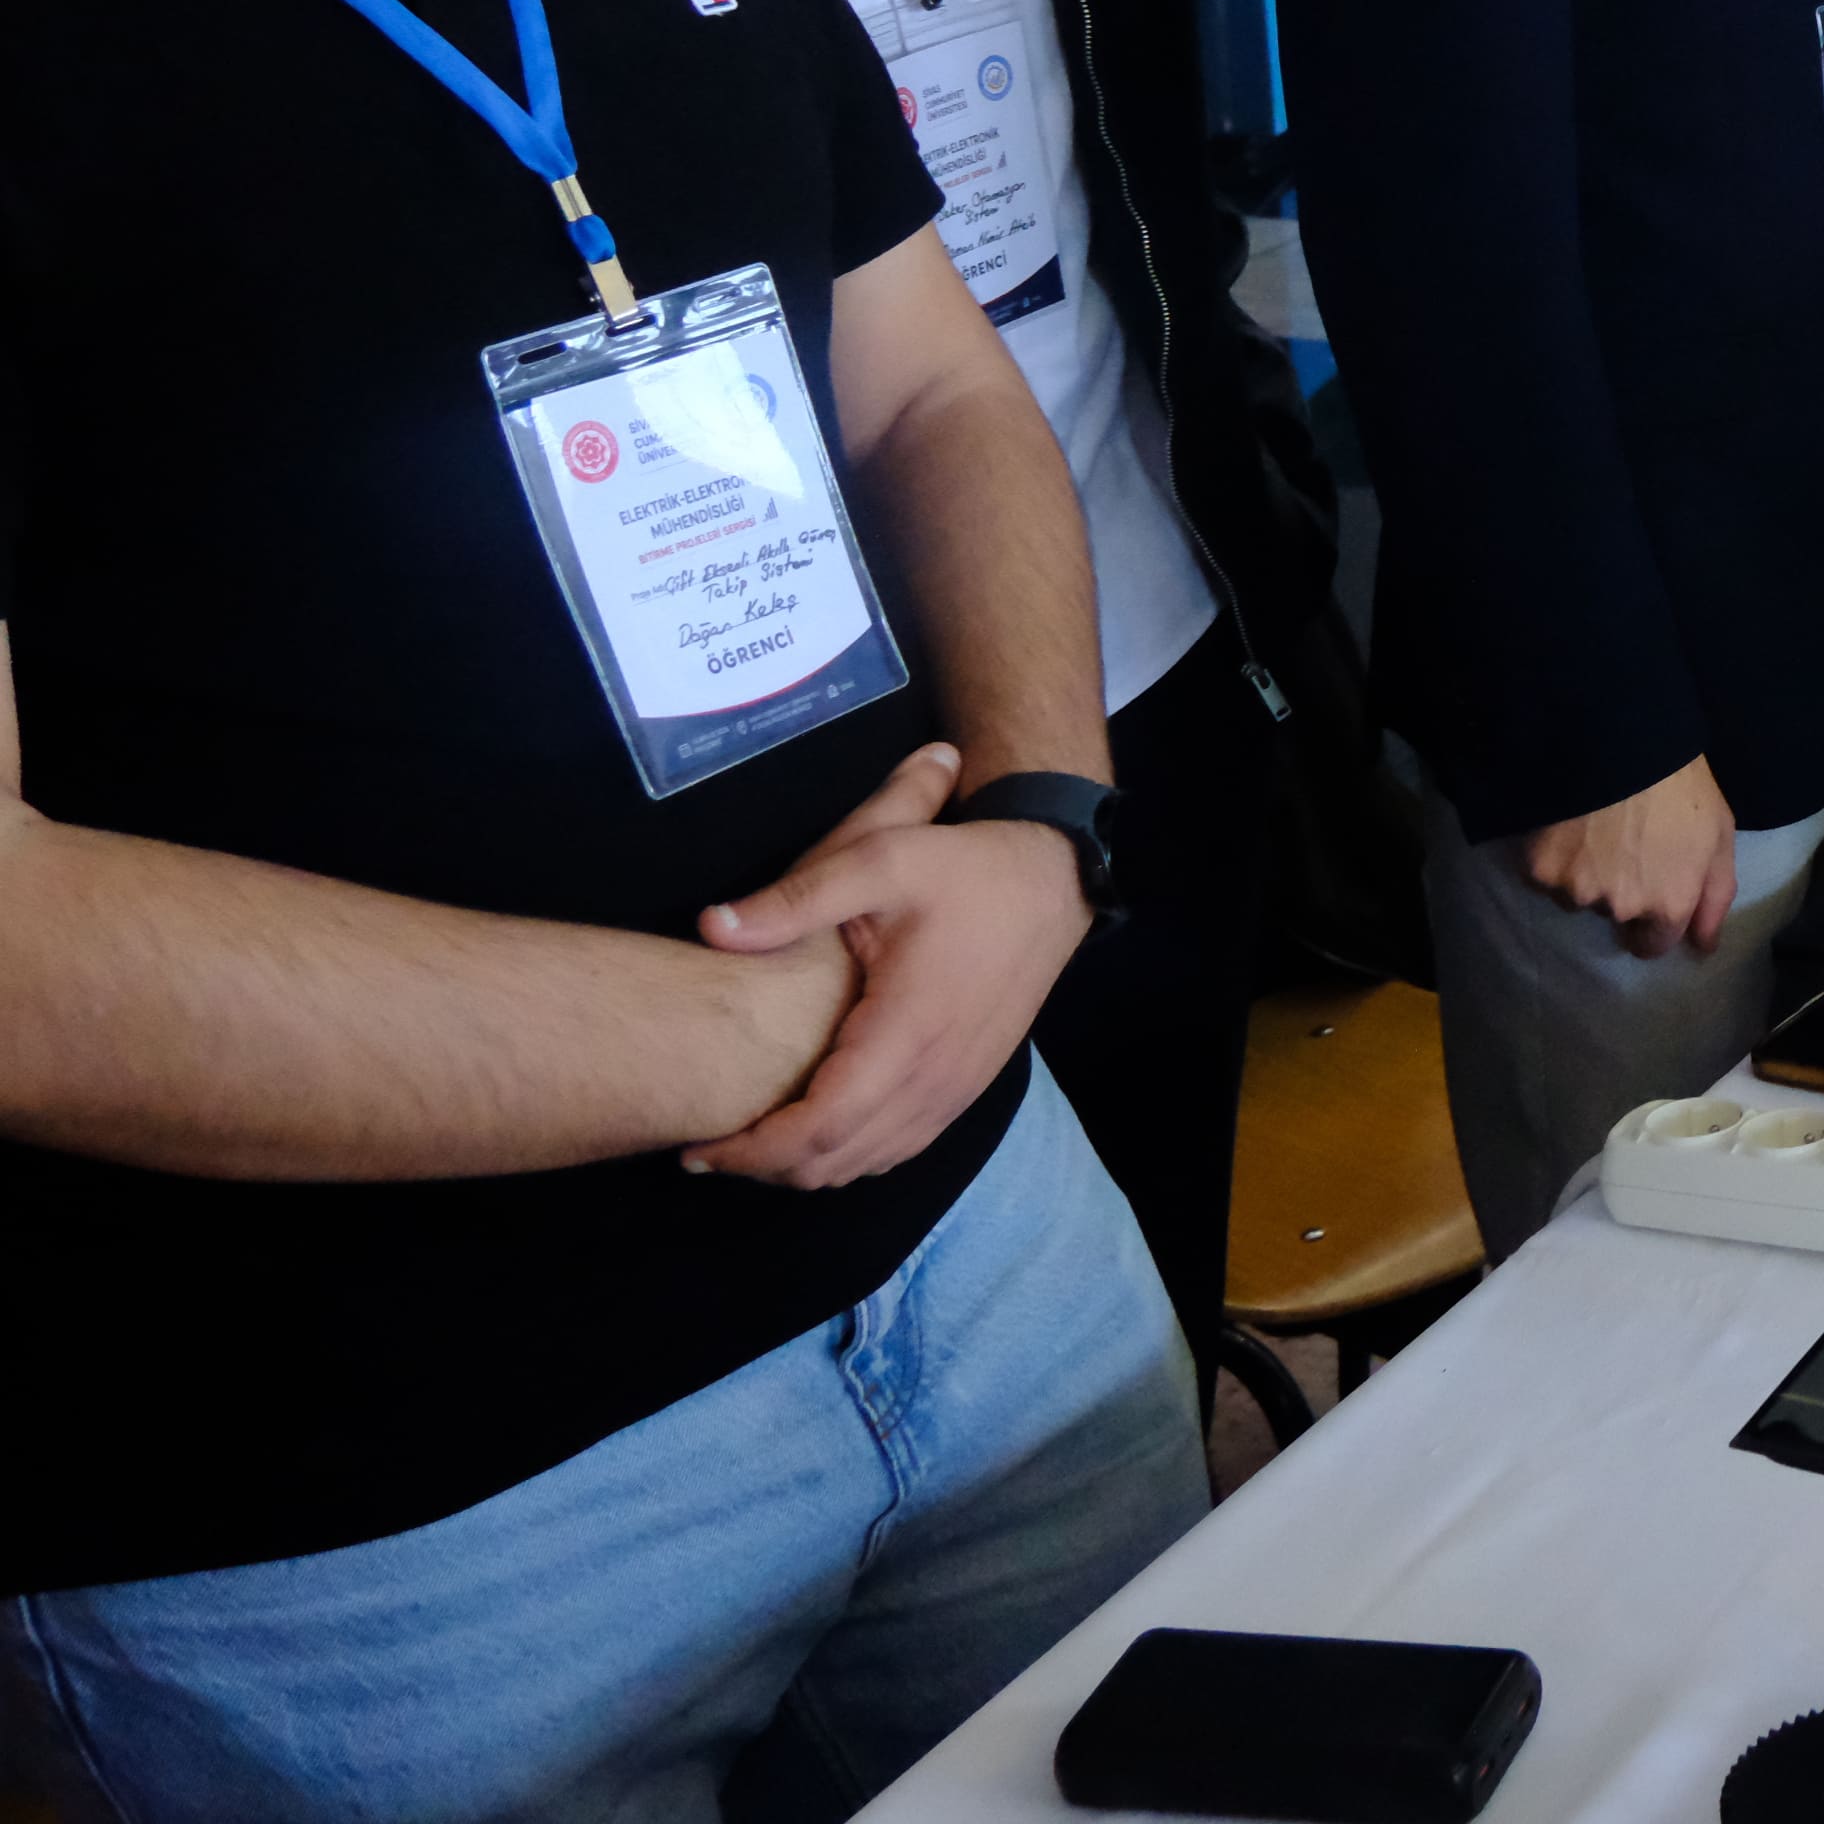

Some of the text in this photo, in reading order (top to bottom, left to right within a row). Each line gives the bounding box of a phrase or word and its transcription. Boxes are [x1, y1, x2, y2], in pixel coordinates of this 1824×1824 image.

[923, 127, 1001, 161] EKTRİK-ELEKTRONİK
[962, 249, 1008, 281] ĞRENCİ
[618, 476, 746, 526] ELEKTRİK-ELEKTRO
[650, 495, 745, 539] MÜHENDİSLİĞİ
[676, 528, 721, 552] PROJELERİ
[723, 517, 757, 536] SERGİSİ
[702, 576, 748, 603] Takip
[707, 625, 795, 674] ÖĞRENCİ
